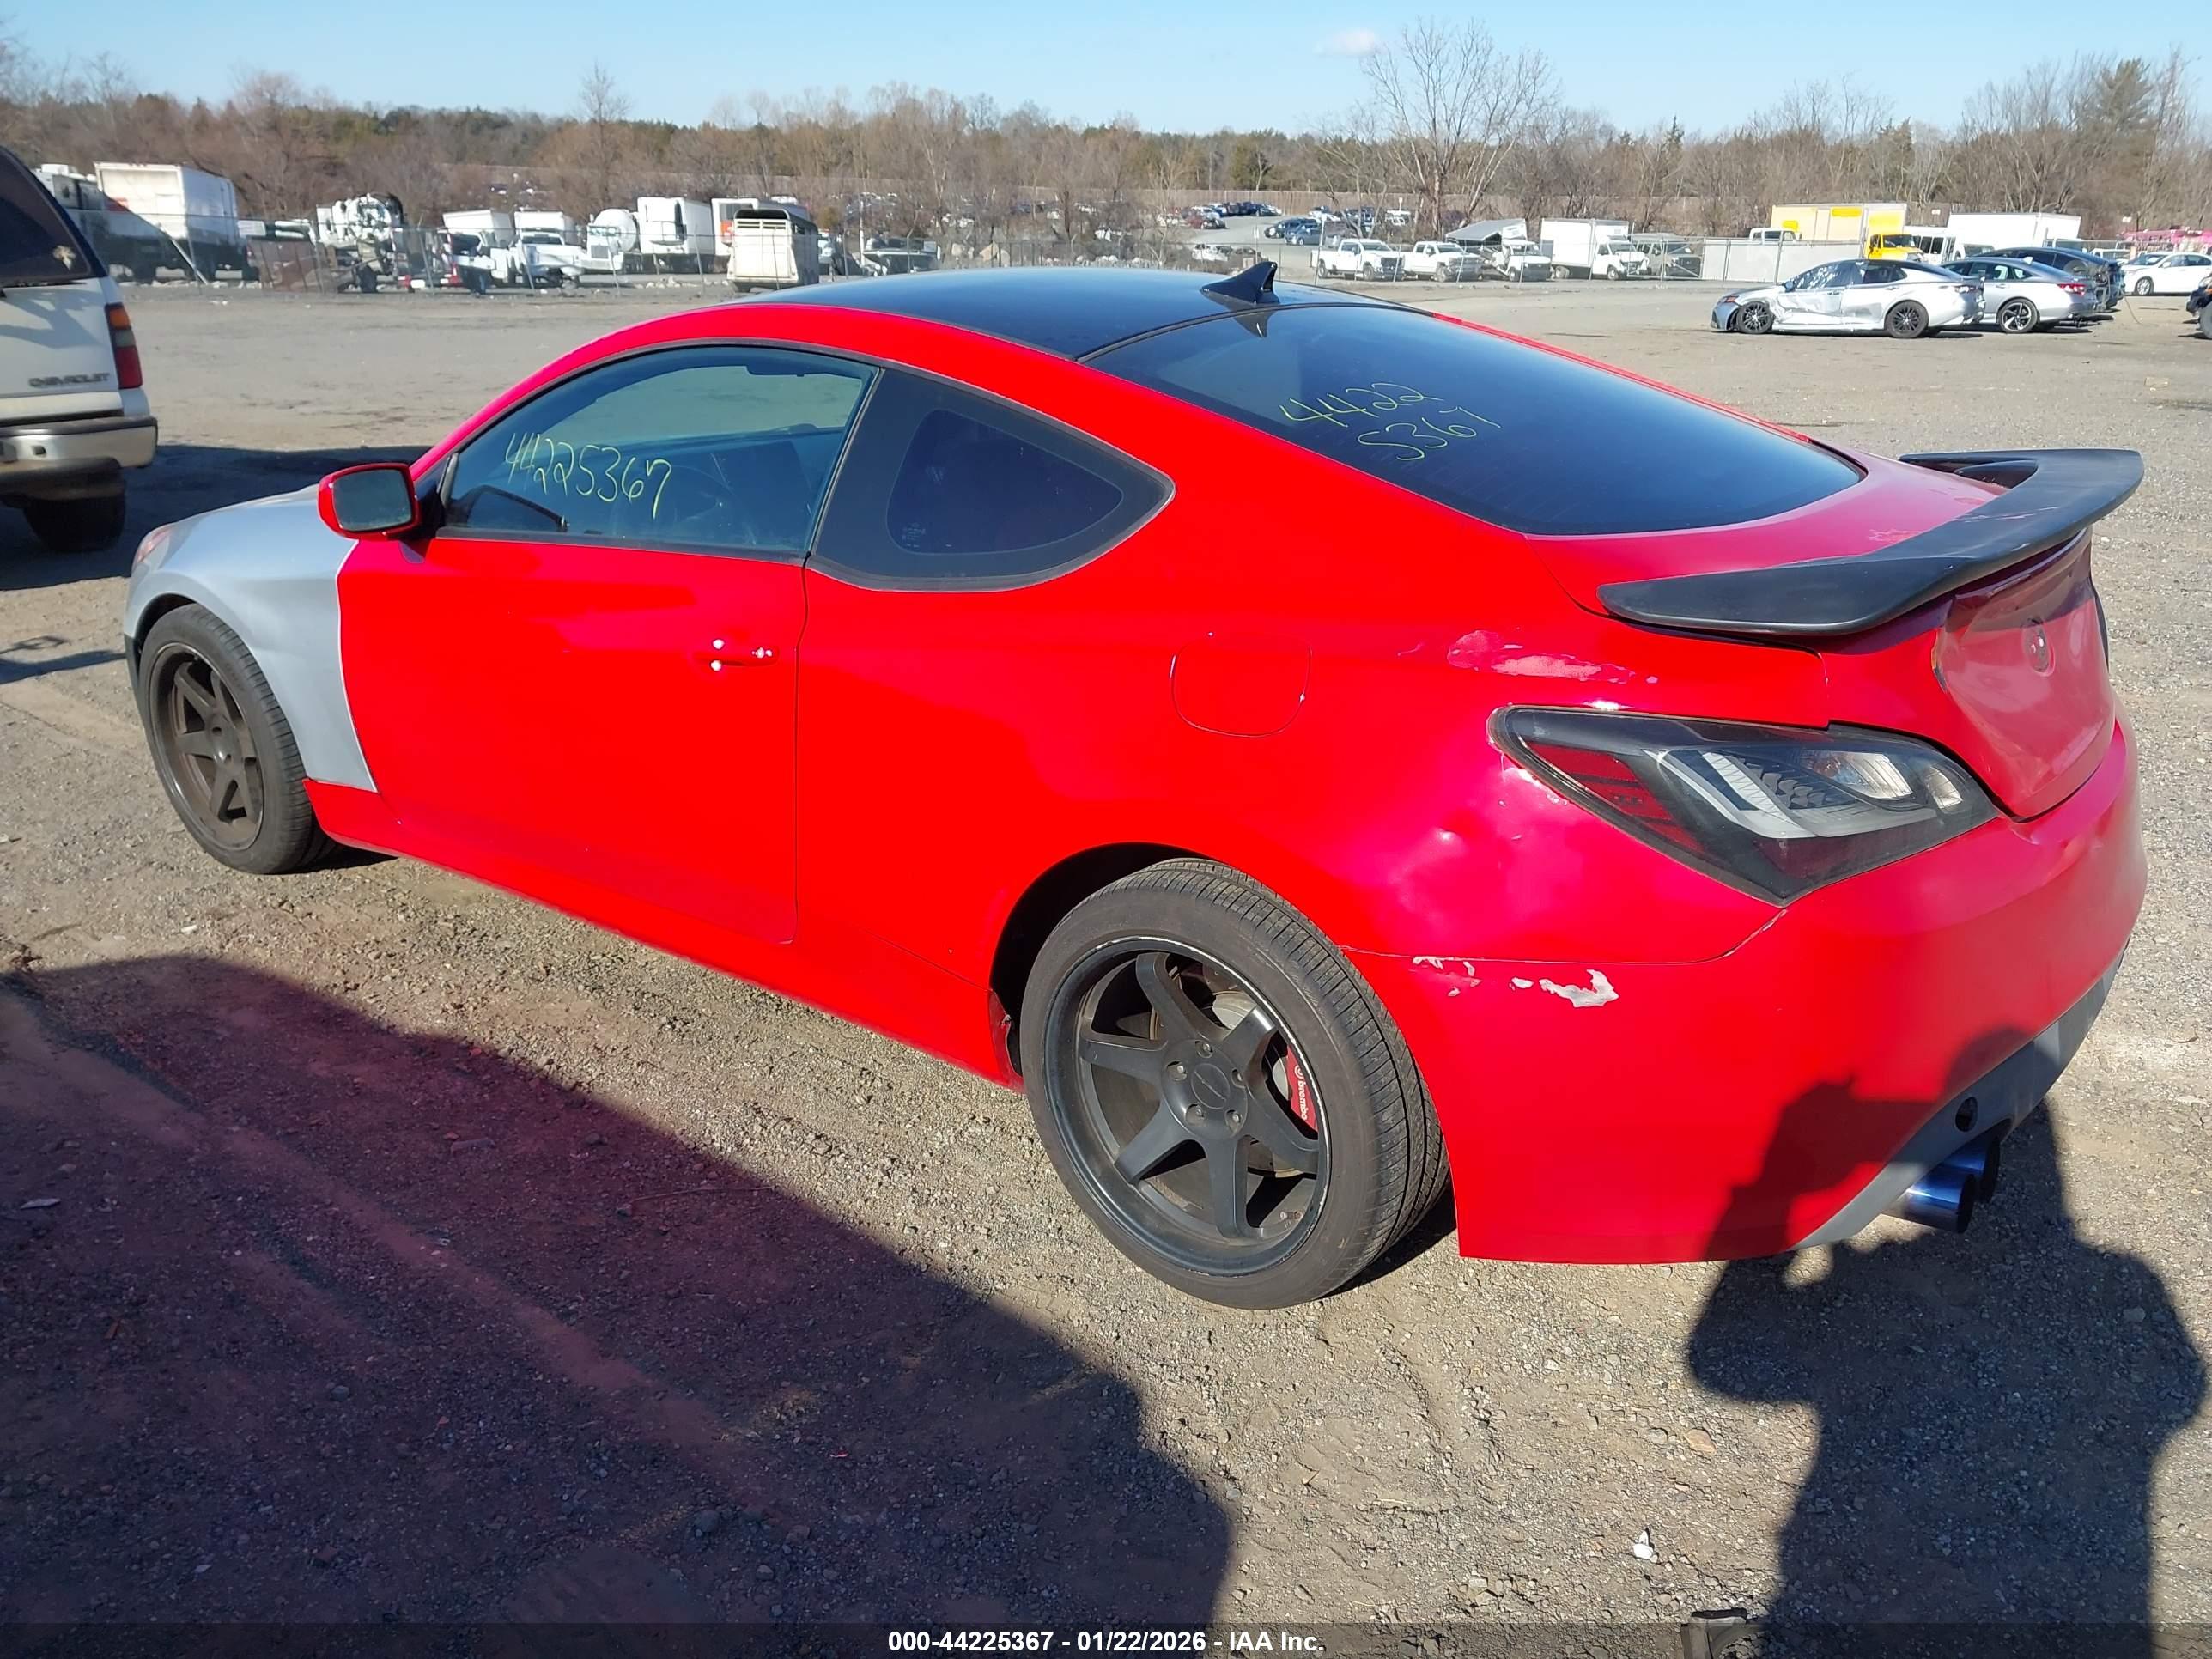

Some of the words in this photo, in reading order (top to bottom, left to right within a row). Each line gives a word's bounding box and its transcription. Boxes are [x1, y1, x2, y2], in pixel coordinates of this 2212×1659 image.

[1279, 383, 1444, 428] 4422
[505, 432, 672, 519] 44225367
[1297, 1079, 1309, 1121] brembo
